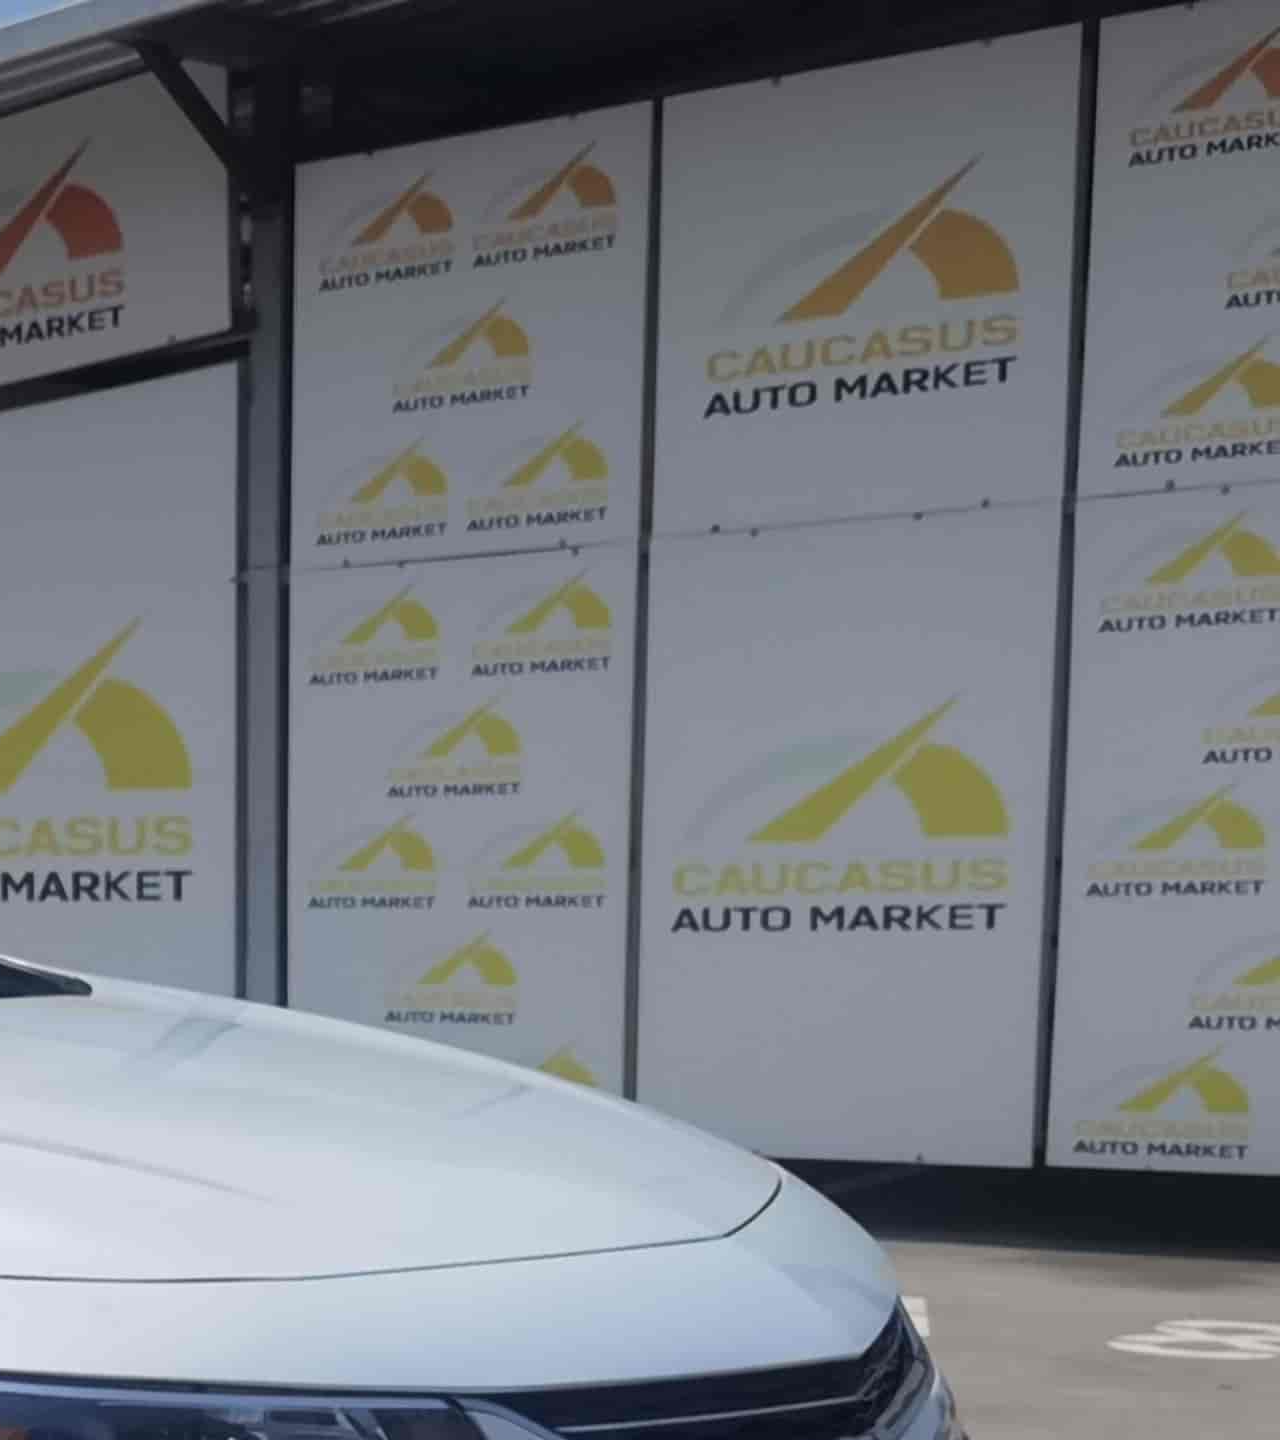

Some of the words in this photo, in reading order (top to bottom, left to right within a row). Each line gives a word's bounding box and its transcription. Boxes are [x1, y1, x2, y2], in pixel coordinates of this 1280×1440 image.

[1129, 110, 1280, 147] CAUCAS
[1128, 143, 1198, 168] AUTO
[1205, 129, 1280, 156] MARK
[472, 247, 528, 269] AUTO
[532, 233, 616, 260] MARKET
[318, 272, 371, 292] AUTO
[375, 259, 453, 283] MARKET
[706, 315, 1019, 383] CAUCASUS
[392, 394, 445, 414] AUTO
[449, 384, 529, 406] MARKET
[703, 381, 817, 419] AUTO
[834, 355, 1017, 403] MARKET
[1116, 419, 1280, 449] CAUCASU
[1113, 449, 1183, 468] AUTO
[1191, 439, 1280, 462] MARKE
[466, 514, 520, 532] AUTO
[525, 506, 607, 527] MARKET
[316, 529, 367, 547] AUTO
[370, 521, 447, 541] MARKET
[1098, 615, 1167, 633] AUTO
[1175, 607, 1278, 628] MARKET
[309, 671, 358, 686] AUTO
[363, 666, 438, 683] MARKET
[471, 662, 524, 677] AUTO
[529, 655, 610, 673] MARKET
[1202, 747, 1273, 764] AUTO
[387, 784, 438, 798] AUTO
[443, 782, 521, 796] MARKET
[0, 870, 193, 902] MARKET
[673, 858, 1009, 896] CAUCASUS
[1085, 881, 1153, 898] AUTO
[1161, 879, 1265, 896] MARKET
[307, 895, 357, 909] AUTO
[360, 895, 435, 909] MARKET
[467, 895, 521, 909] AUTO
[524, 895, 605, 908] MARKET
[671, 906, 792, 933] AUTO
[809, 903, 1005, 932] MARKET
[384, 1010, 435, 1024] AUTO
[439, 1011, 514, 1025] MARKET
[1188, 1015, 1257, 1031] AUTO
[1073, 1139, 1139, 1156] AUTO
[1146, 1142, 1249, 1160] MARKET
